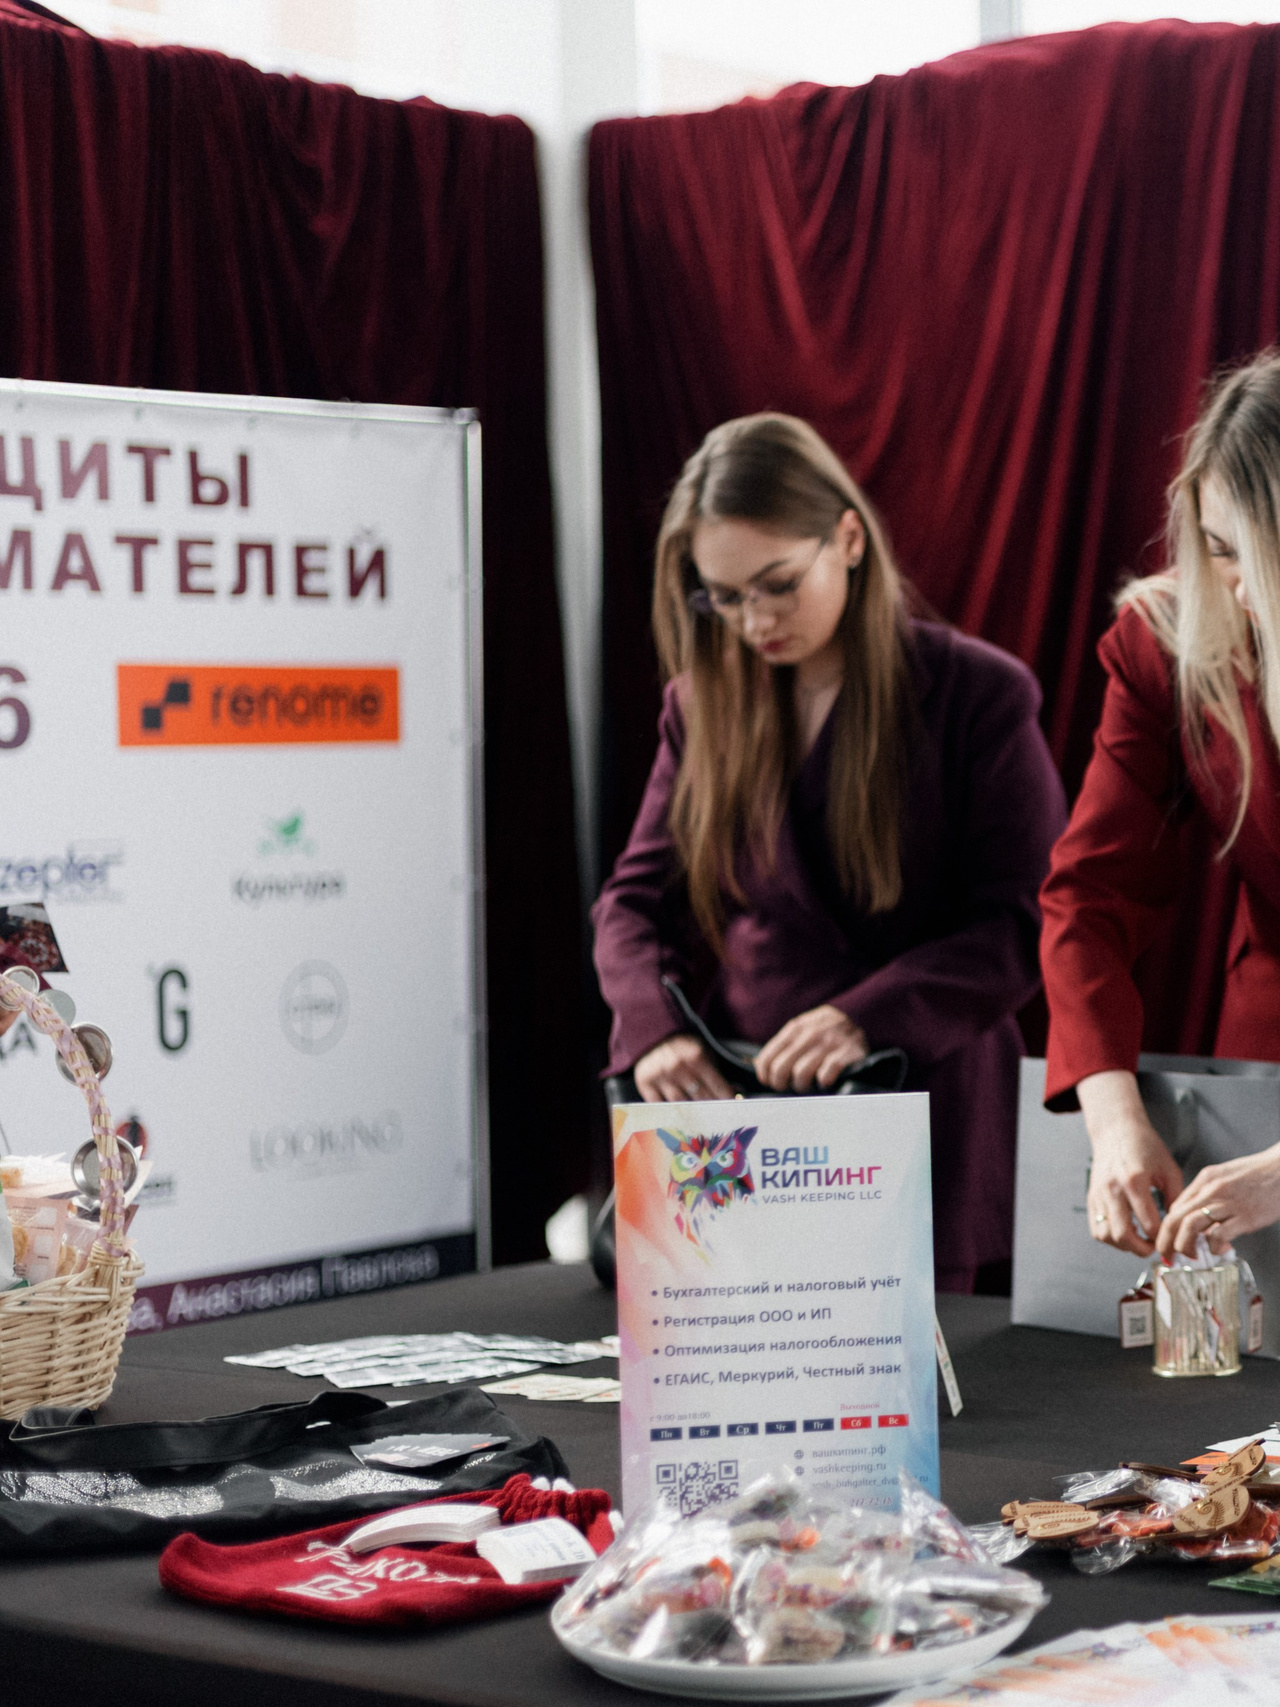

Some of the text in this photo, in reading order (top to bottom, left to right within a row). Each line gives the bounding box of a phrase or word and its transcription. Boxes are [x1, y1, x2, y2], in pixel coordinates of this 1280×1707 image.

[211, 684, 384, 728] renome
[761, 1146, 829, 1167] ВАШ
[761, 1165, 882, 1189] КИПИНГ
[762, 1190, 882, 1204] VASH KEEPING LLC
[663, 1275, 902, 1301] Бухгалтерский и налоговый учёт
[664, 1307, 832, 1328] Регистрация ООО и ИП
[664, 1335, 902, 1357] Оптимизация налогообложения
[665, 1362, 902, 1386] ЕГАИС, Меркурий, Честный знак
[840, 1401, 880, 1411] Выходной
[736, 1425, 750, 1435] Ср
[812, 1444, 887, 1458] вашкипинг.рф
[813, 1463, 887, 1474] vashkeeping.ru
